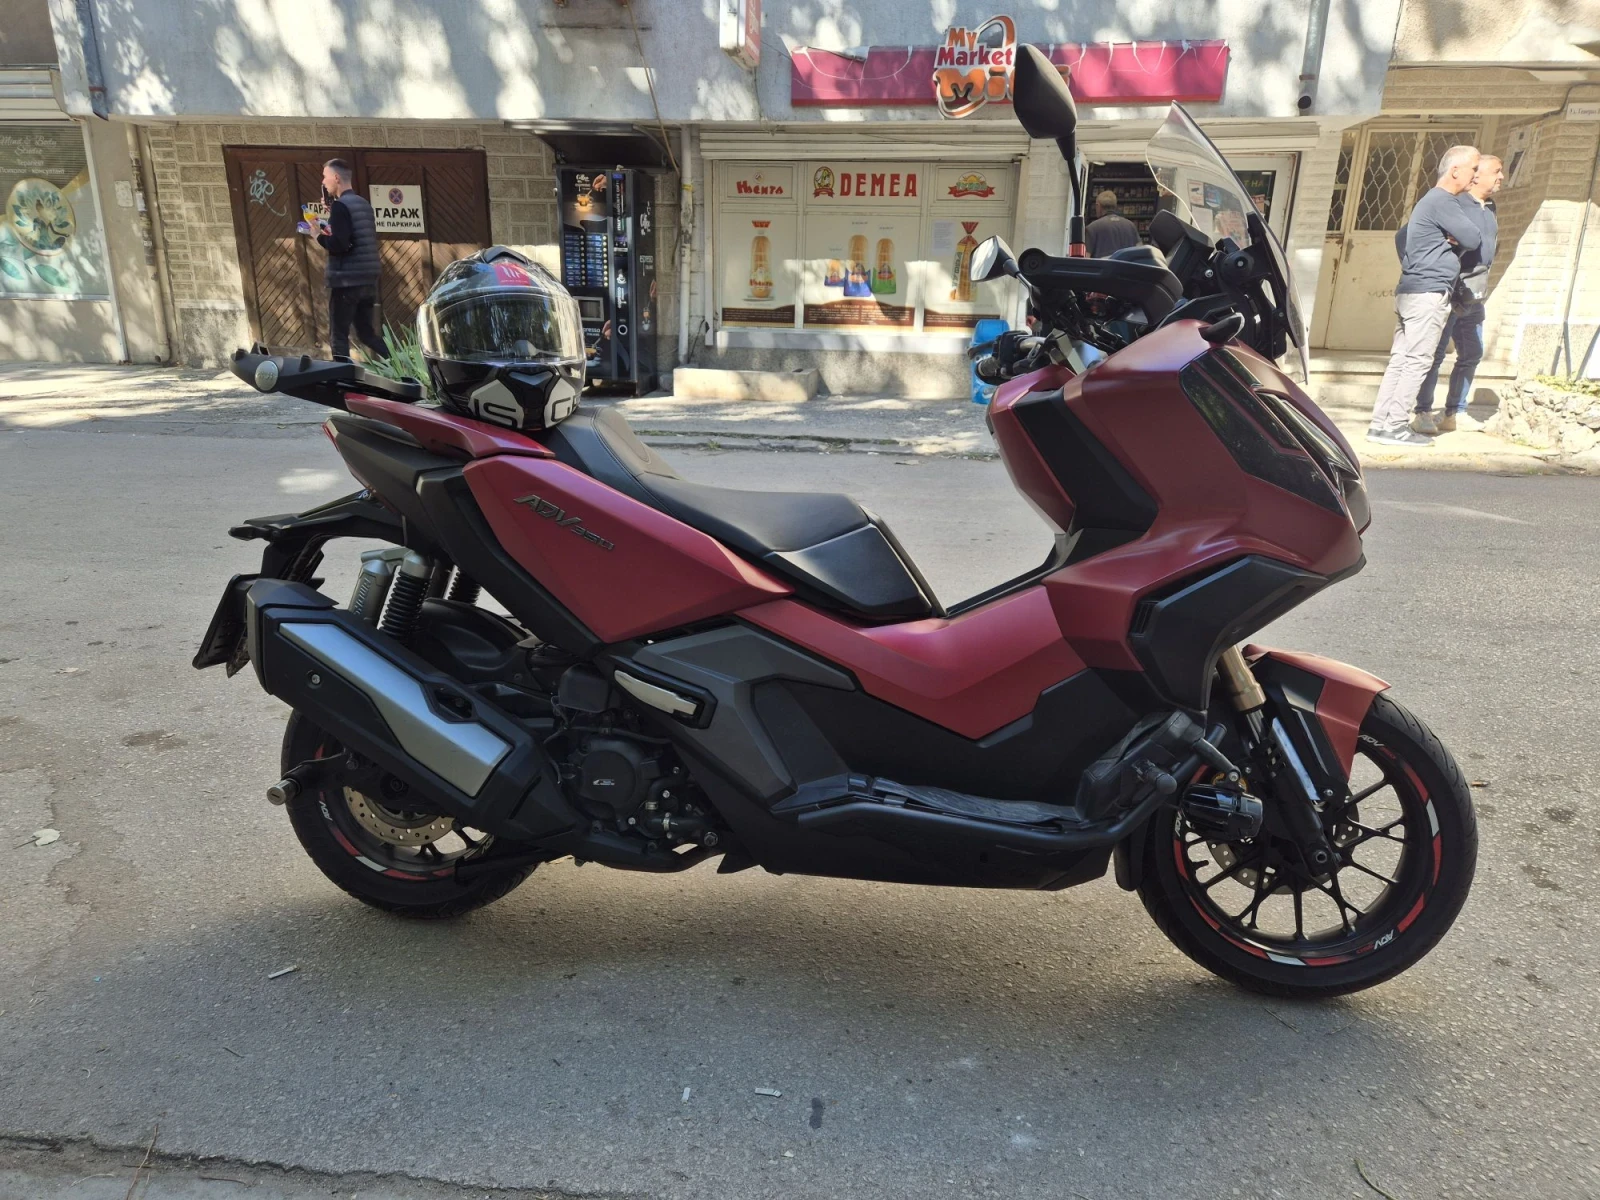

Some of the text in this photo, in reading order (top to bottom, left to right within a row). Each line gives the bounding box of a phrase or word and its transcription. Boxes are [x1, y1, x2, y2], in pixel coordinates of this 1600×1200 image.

[947, 27, 977, 51] My
[937, 46, 1012, 66] Market
[840, 173, 917, 197] DEMEA
[375, 208, 420, 219] ГАРАЖ
[1357, 734, 1385, 746] ADV
[1373, 929, 1394, 950] ADV
